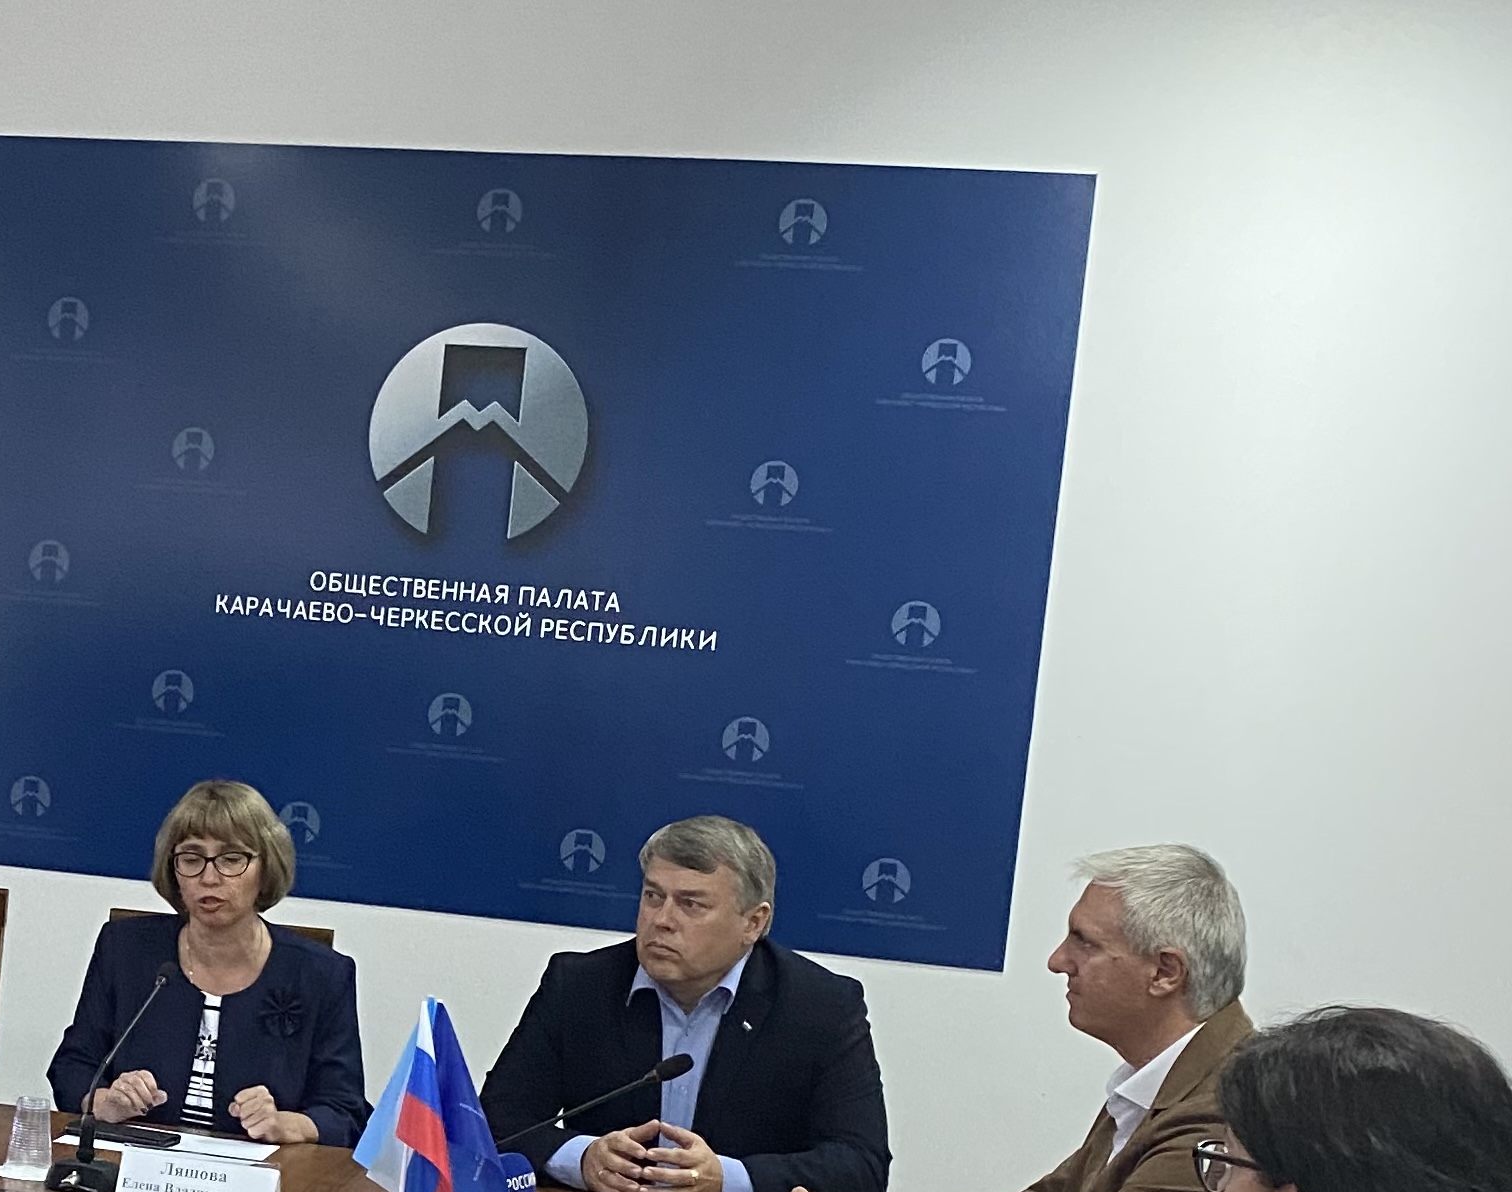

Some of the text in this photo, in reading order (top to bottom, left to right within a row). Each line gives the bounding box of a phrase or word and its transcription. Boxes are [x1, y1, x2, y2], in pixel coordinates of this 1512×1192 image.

[309, 570, 620, 613] ОБЩЕСТВЕННАЯ ПАЛАТА
[215, 593, 718, 651] КАРАЧАЕВО-ЧЕРКЕССКОЙ РЕСПУБЛИКИ
[122, 1177, 160, 1192] Елена
[160, 1162, 227, 1183] Ляшова
